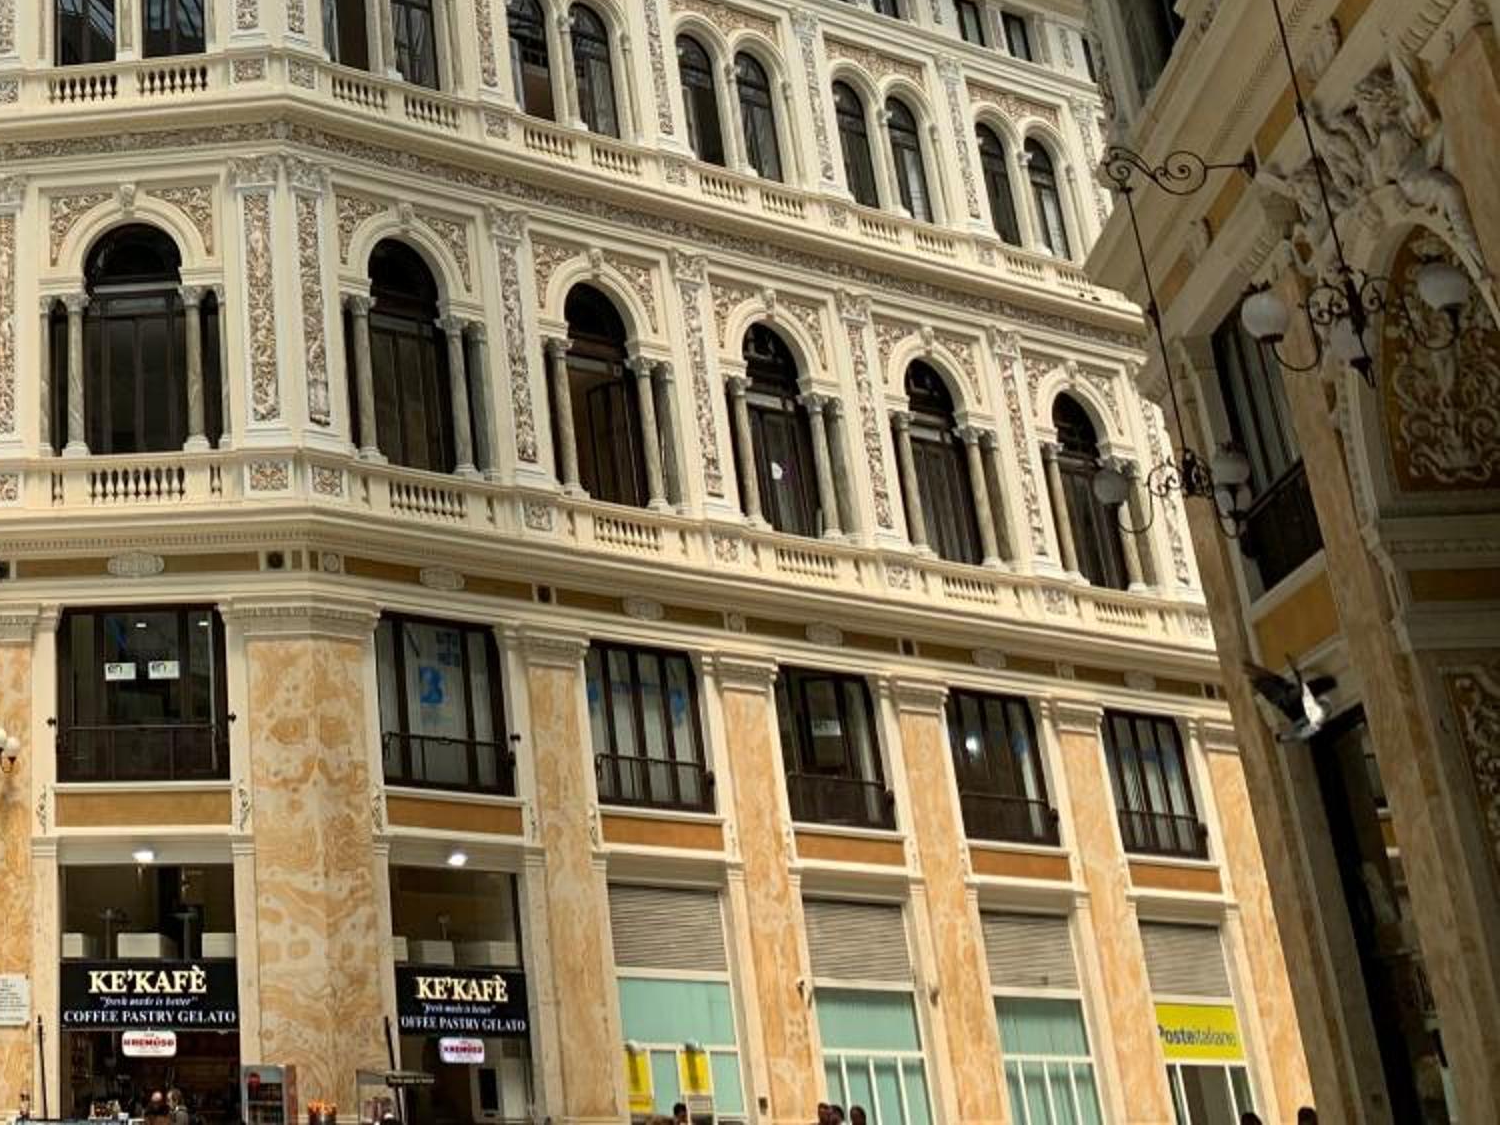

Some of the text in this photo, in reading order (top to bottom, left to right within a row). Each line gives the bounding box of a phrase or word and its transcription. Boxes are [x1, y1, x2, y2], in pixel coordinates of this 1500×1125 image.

[88, 965, 207, 994] KE'KAFÈ
[415, 974, 509, 1002] KE'KAFÈ
[64, 1011, 236, 1023] COFFEE PASTRY GELATO
[401, 1016, 526, 1032] OFFEE PASTRY GELATO
